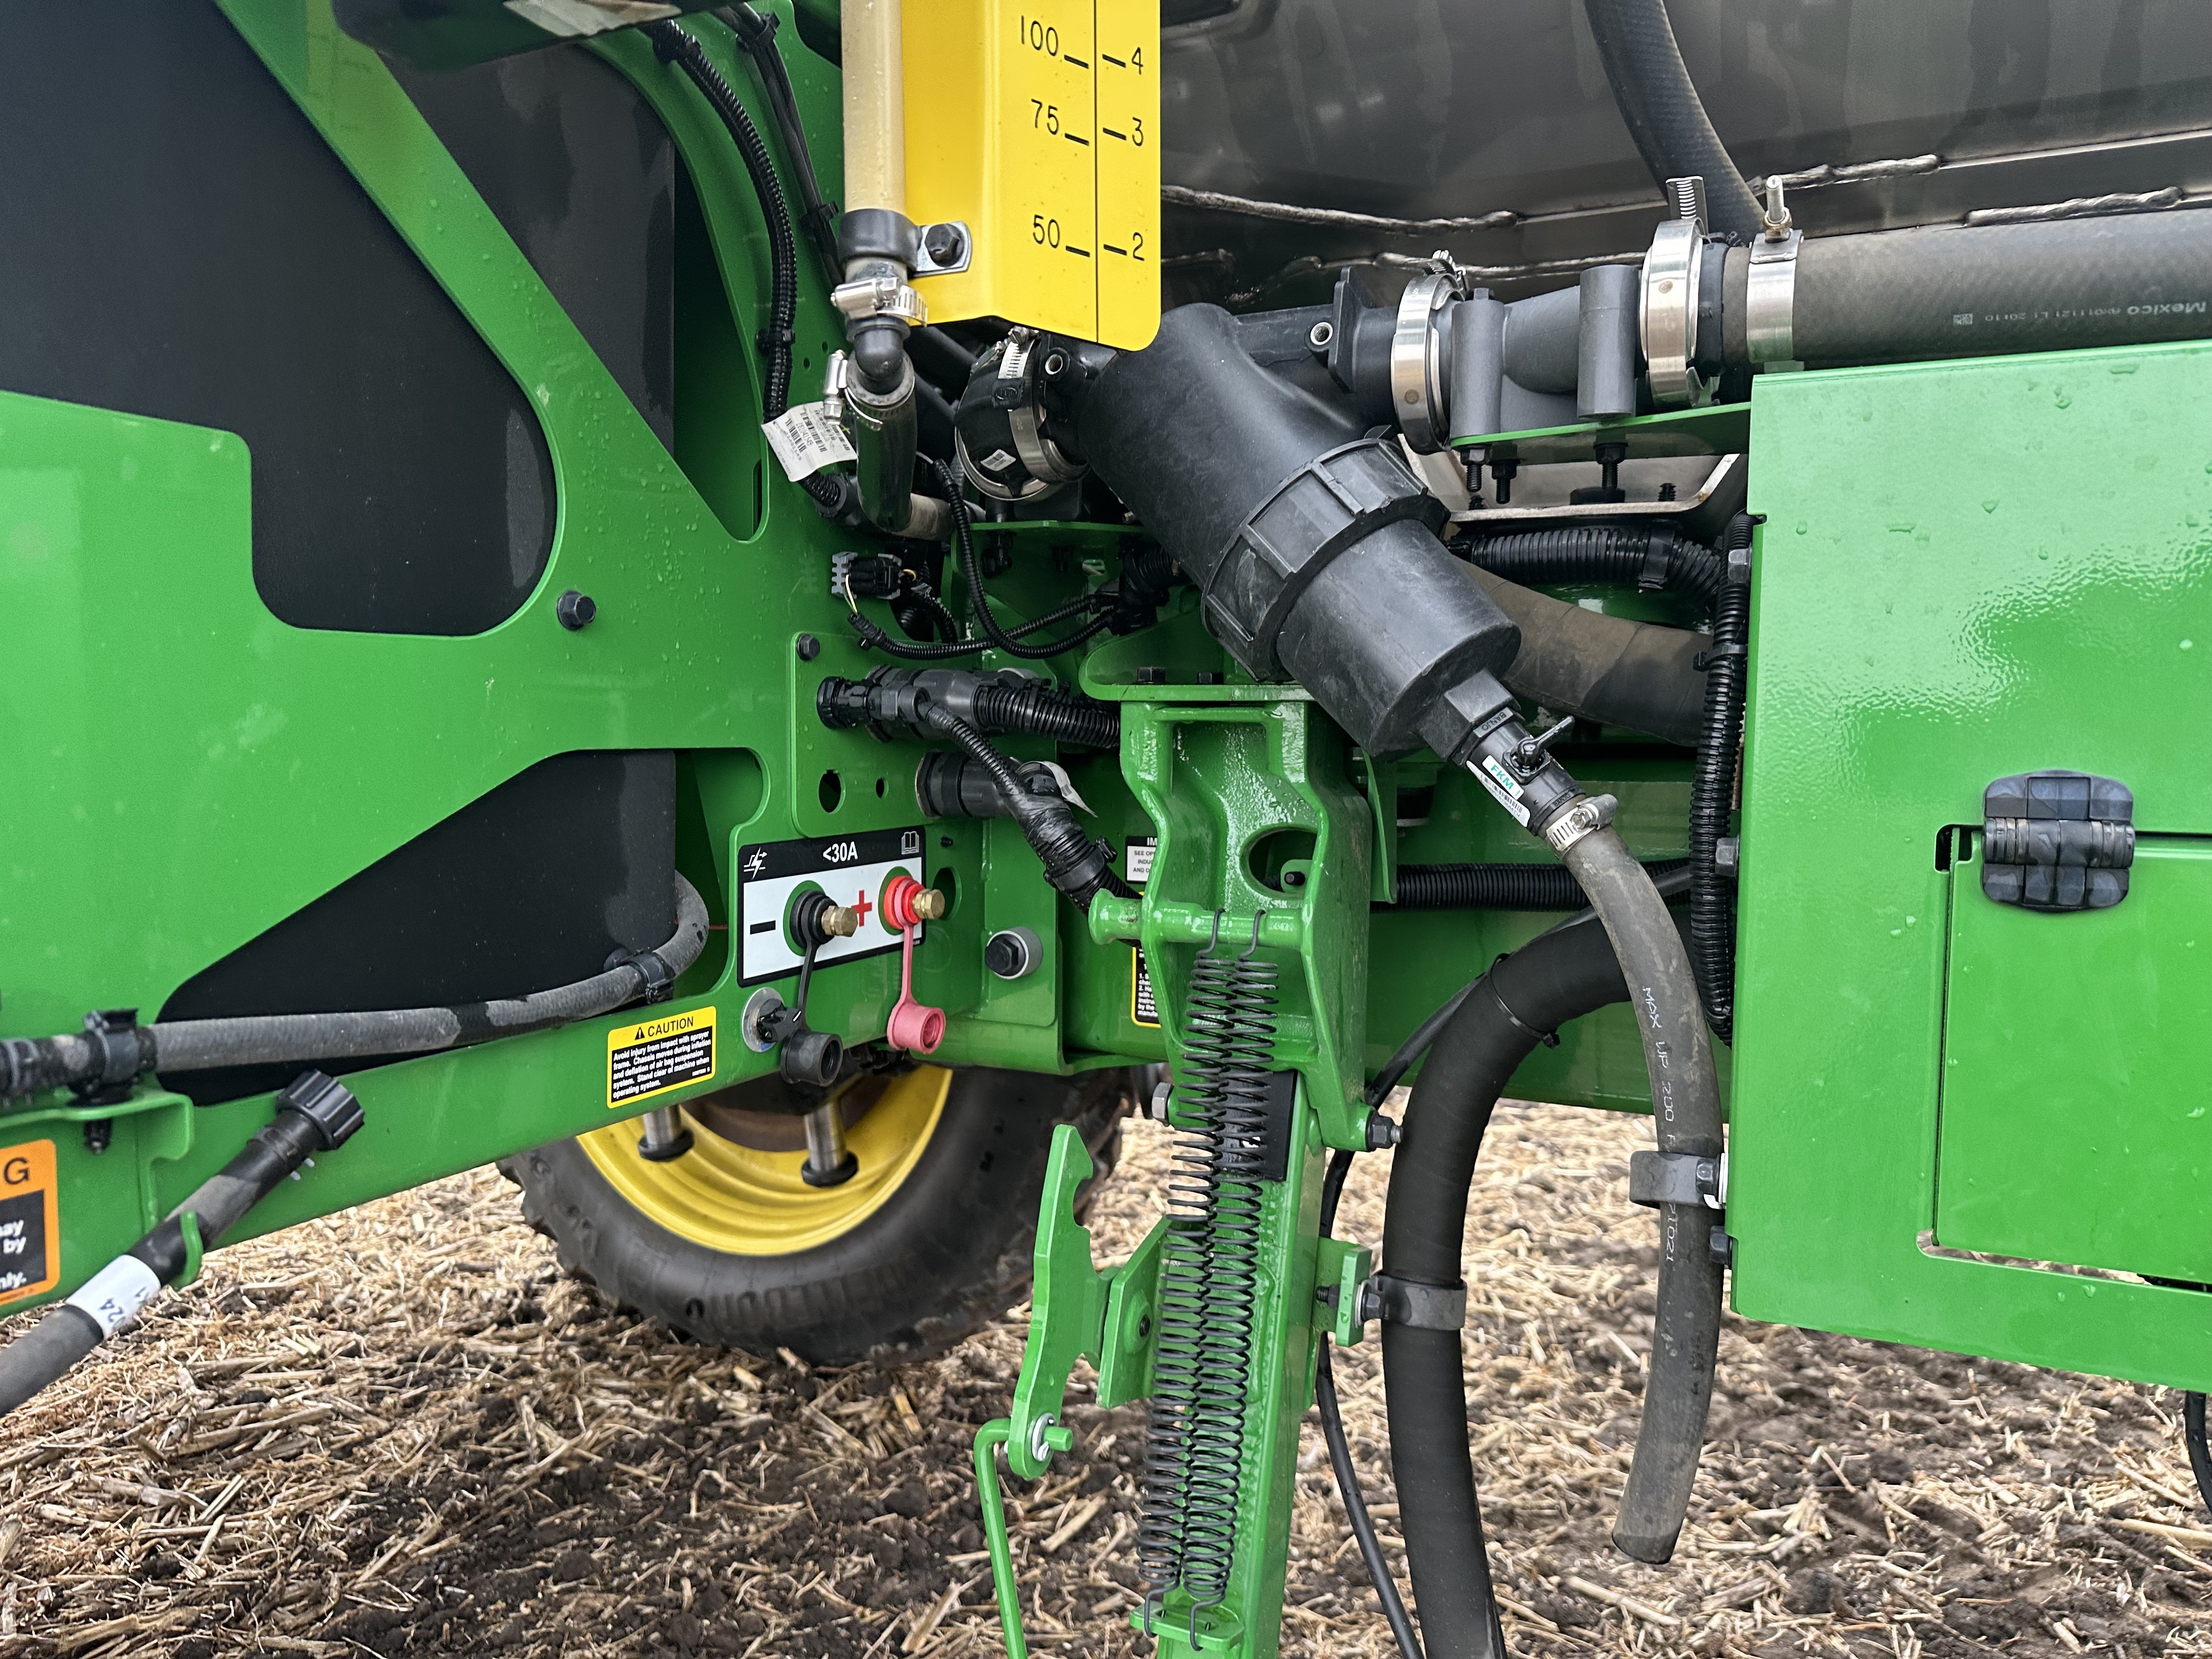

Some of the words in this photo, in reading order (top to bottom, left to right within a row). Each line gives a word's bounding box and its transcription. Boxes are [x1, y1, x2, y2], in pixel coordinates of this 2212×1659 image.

[1019, 15, 1059, 57] 100
[1131, 47, 1144, 75] 4
[1030, 98, 1059, 135] 75
[1132, 117, 1144, 147] 3
[1032, 215, 1060, 249] 50
[1132, 233, 1145, 262] 2
[2126, 301, 2207, 315] Mexico
[1481, 712, 1507, 731] BANJO
[1490, 764, 1515, 790] FKM
[822, 842, 858, 863] <30A
[648, 1016, 693, 1036] CAUTION
[613, 1050, 630, 1061] Avoid
[630, 1047, 646, 1058] injury
[647, 1043, 659, 1053] from
[661, 1038, 678, 1049] impact
[679, 1035, 690, 1044] with
[690, 1031, 709, 1042] sprayer
[613, 1061, 631, 1070] frame.
[633, 1054, 655, 1065] Chassis
[656, 1050, 673, 1059] moves
[674, 1045, 690, 1054] during
[691, 1039, 711, 1049] inflation
[1642, 986, 1662, 1028] MAX
[1661, 1081, 1674, 1122] 200
[613, 1070, 624, 1080] and
[625, 1064, 648, 1077] deflation
[650, 1062, 656, 1070] of
[664, 1057, 674, 1067] bag
[675, 1049, 704, 1063] suspension
[613, 1078, 635, 1090] system.
[637, 1072, 653, 1082] Stand
[654, 1068, 667, 1078] clear
[667, 1065, 674, 1074] of
[674, 1060, 696, 1072] machine
[696, 1057, 709, 1066] when
[613, 1085, 639, 1099] operating
[640, 1079, 661, 1091] system.
[4, 1157, 30, 1185] G
[3, 1237, 26, 1254] by
